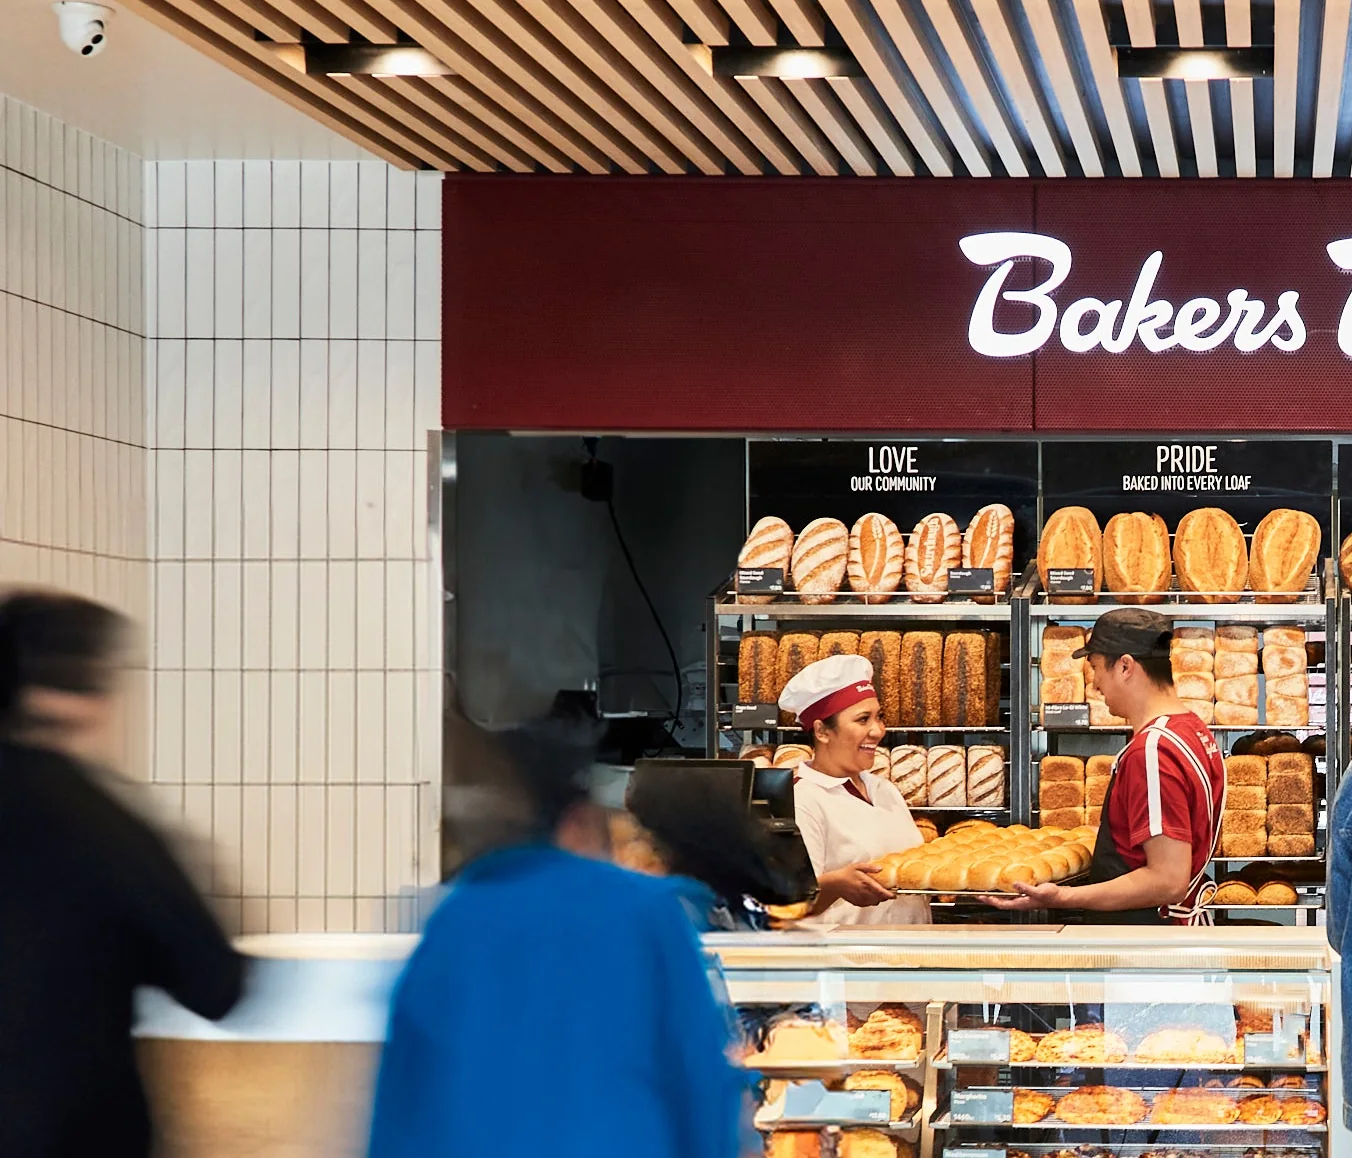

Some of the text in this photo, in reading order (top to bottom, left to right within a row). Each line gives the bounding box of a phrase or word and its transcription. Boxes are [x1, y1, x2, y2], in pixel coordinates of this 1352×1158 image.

[958, 231, 1309, 358] Bakers
[868, 445, 919, 474] LOVE
[1156, 444, 1218, 473] PRIDE
[850, 475, 937, 492] OUR COMMUNITY
[1122, 475, 1252, 491] BAKED INTO EVERY LOAF
